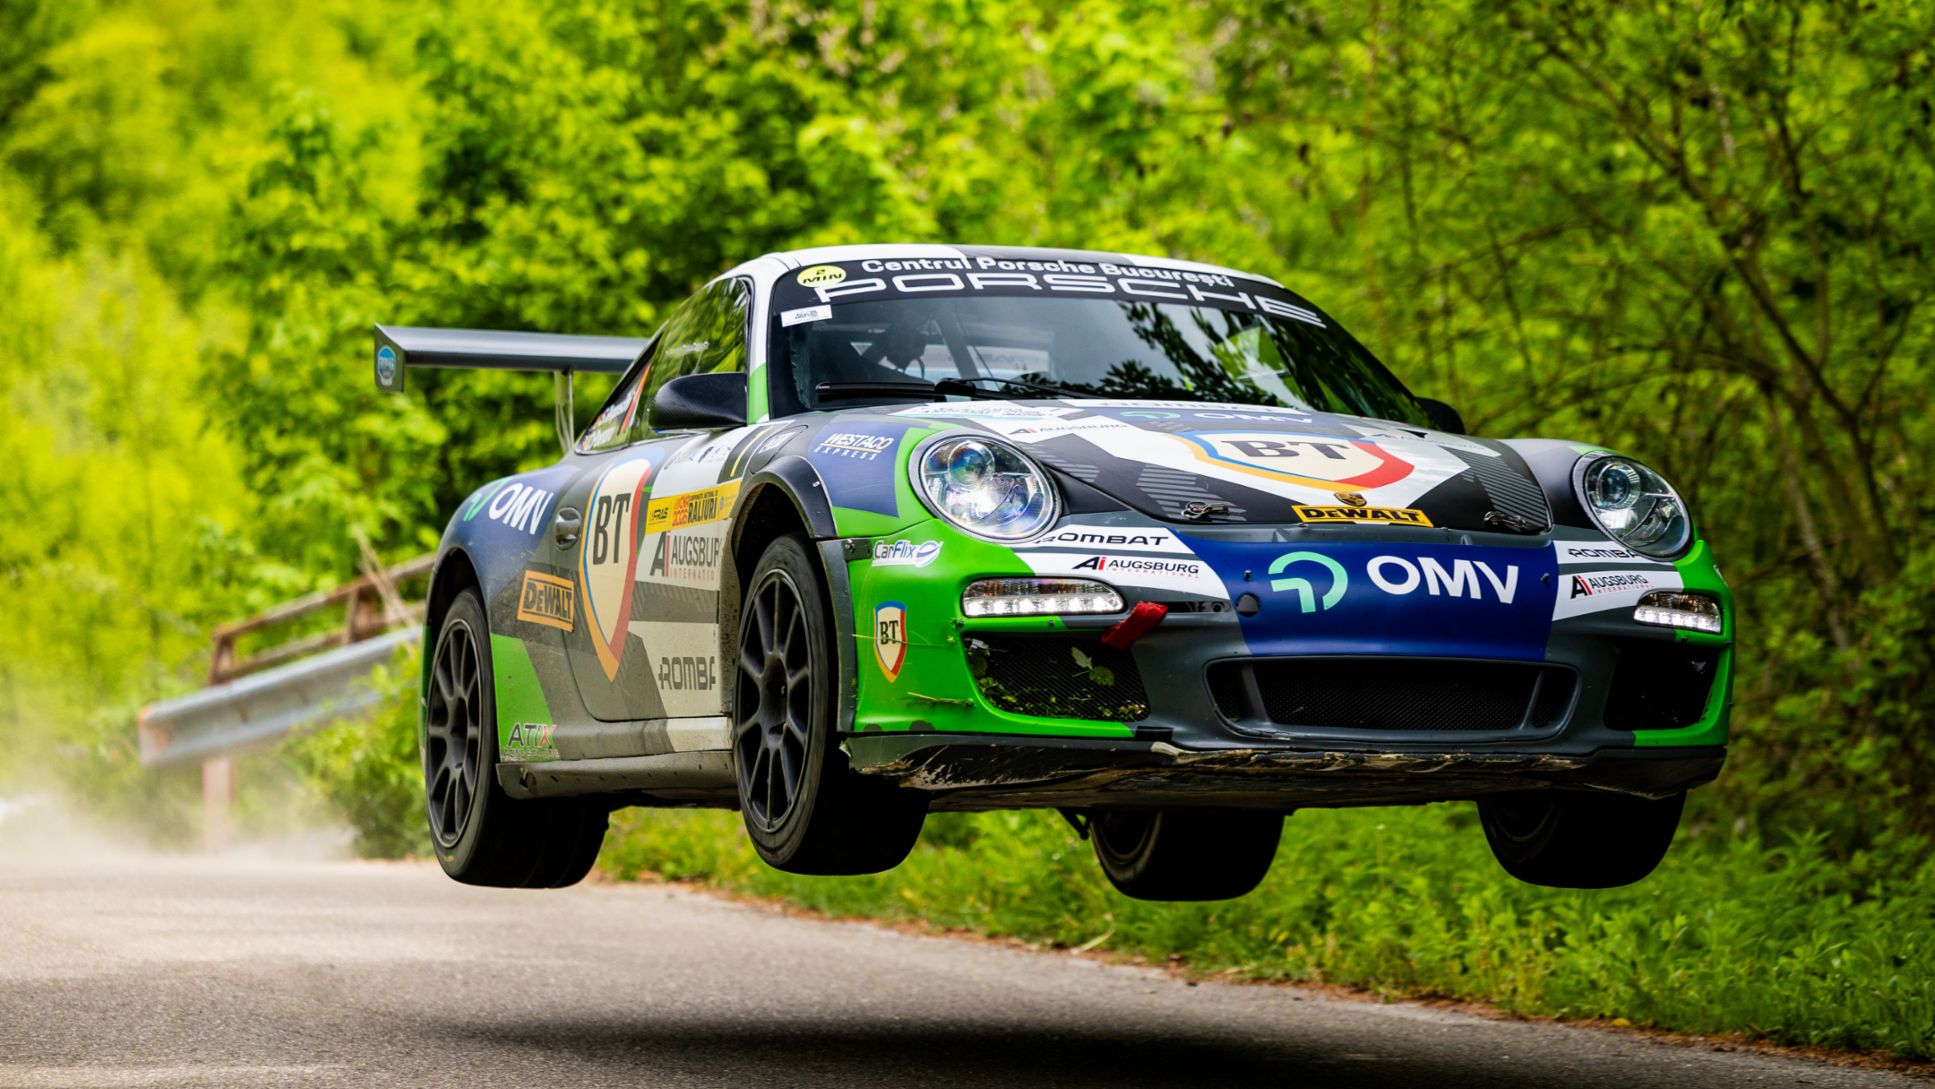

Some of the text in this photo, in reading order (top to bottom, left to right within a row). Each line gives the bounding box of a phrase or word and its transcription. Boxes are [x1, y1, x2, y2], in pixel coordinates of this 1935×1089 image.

[861, 256, 972, 273] Centrul
[975, 256, 1096, 275] Porsche
[802, 273, 843, 284] MIN
[814, 272, 1328, 329] PORSCHE
[1193, 412, 1313, 424] OMV
[824, 433, 895, 450] WESTACO
[1220, 440, 1351, 461] BT
[813, 445, 879, 461] EXPRESS
[488, 483, 554, 535] OMV
[592, 492, 632, 565] BT
[874, 541, 917, 559] CarFlix
[1107, 559, 1200, 574] AUGSBURG
[1366, 555, 1519, 604] OMV
[1588, 575, 1649, 589] AUGSBURG
[879, 620, 899, 645] BT
[508, 724, 557, 747] ATIX
